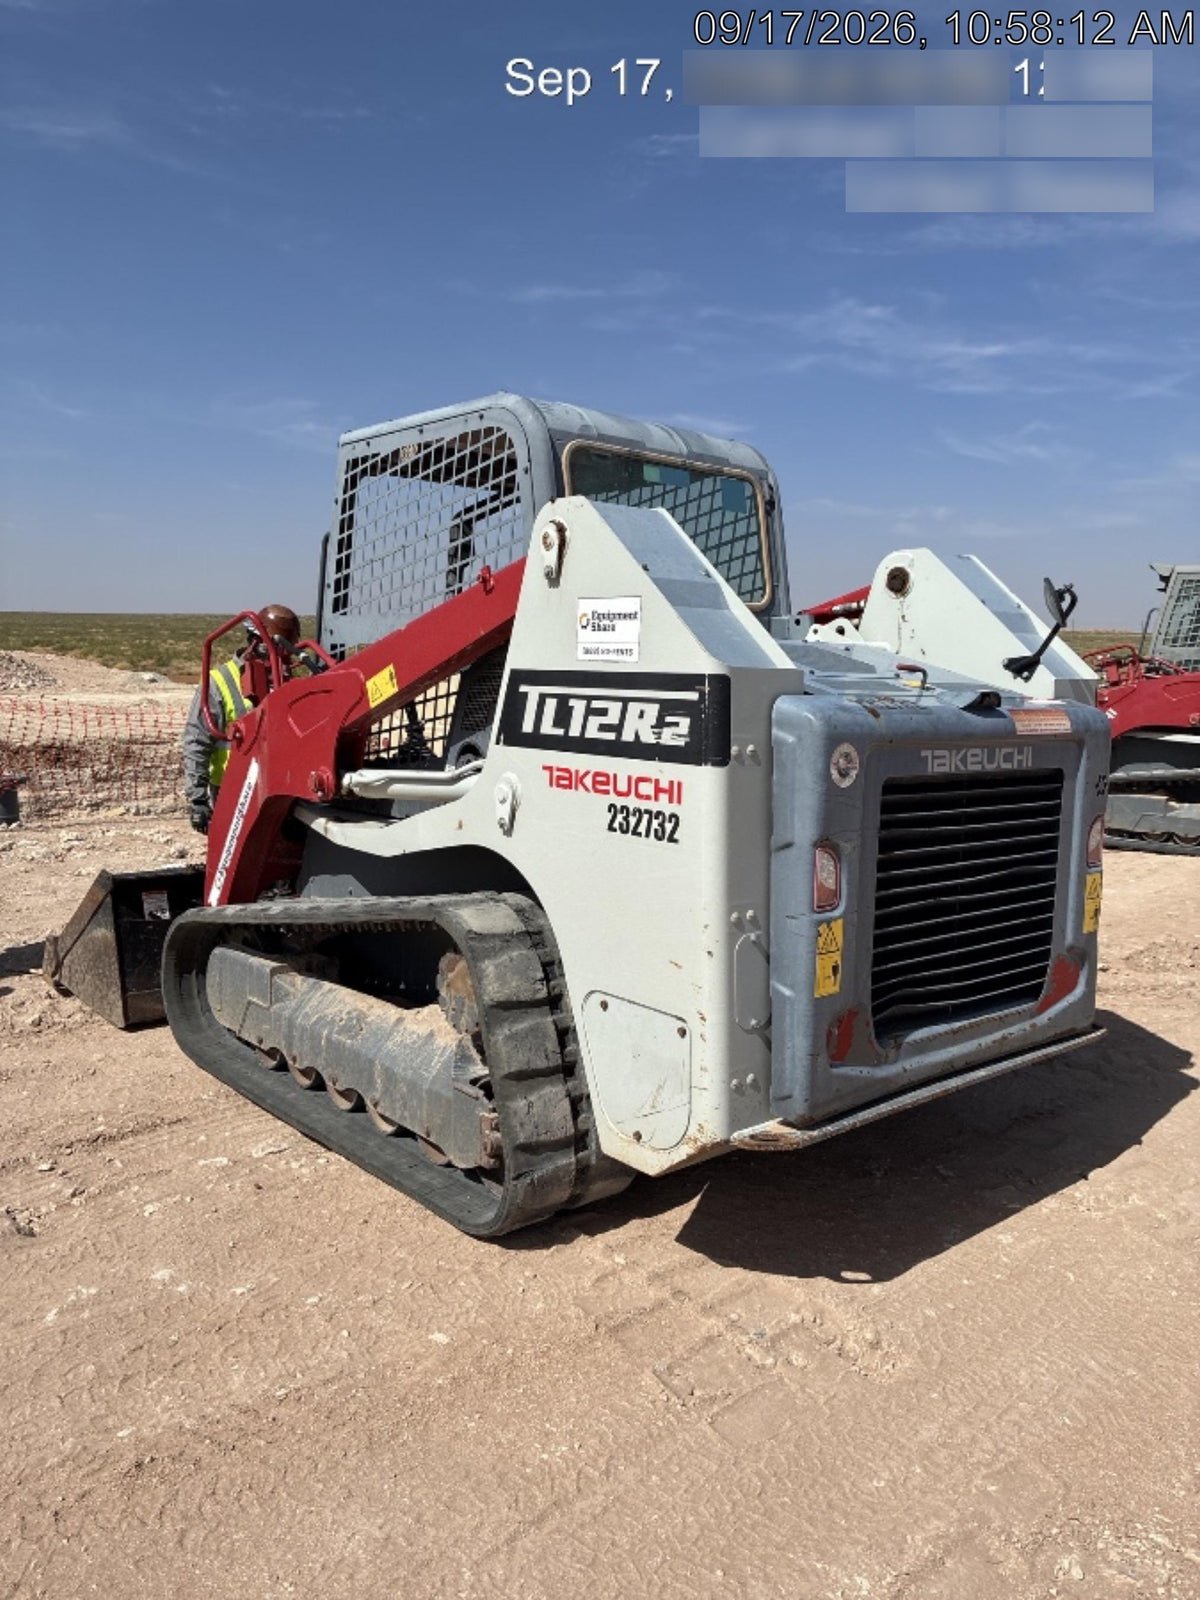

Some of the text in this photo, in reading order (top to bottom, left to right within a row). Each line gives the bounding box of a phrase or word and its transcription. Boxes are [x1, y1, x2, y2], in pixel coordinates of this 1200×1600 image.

[591, 611, 638, 622] Equipment
[591, 622, 616, 632] Share
[607, 803, 681, 844] 232732
